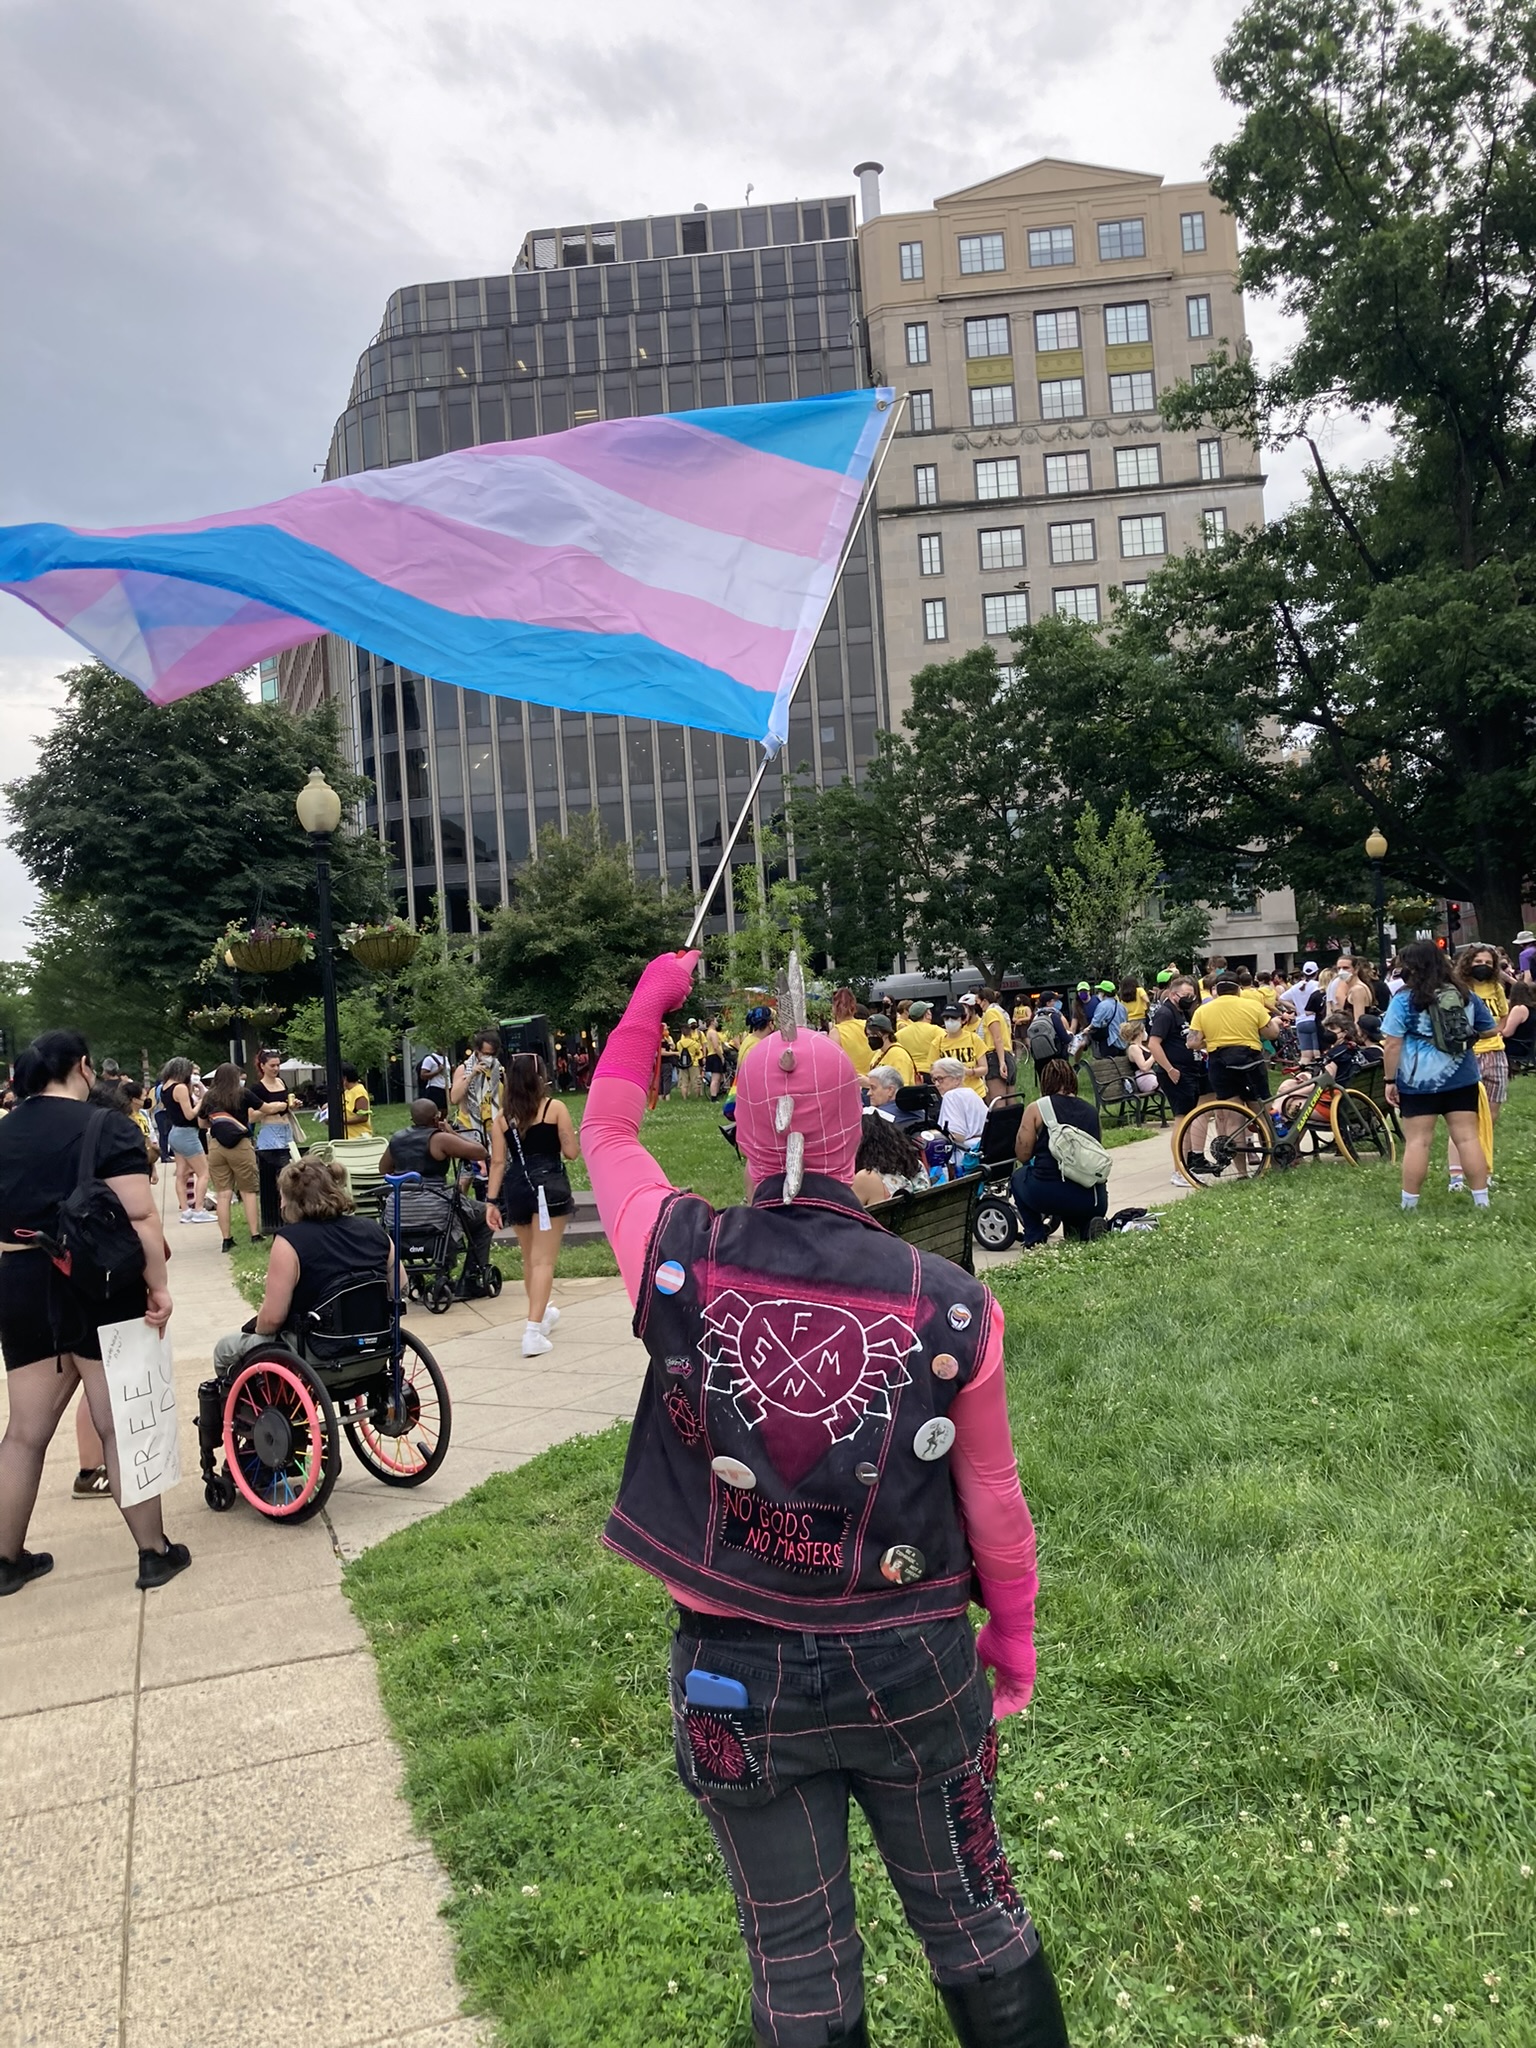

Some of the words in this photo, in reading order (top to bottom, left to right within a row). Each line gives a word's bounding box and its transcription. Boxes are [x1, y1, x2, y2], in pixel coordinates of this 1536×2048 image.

[1297, 1106, 1313, 1132] SANTA
[1310, 1086, 1323, 1107] CRUZ
[791, 1312, 812, 1342] F
[751, 1336, 772, 1369] S
[816, 1350, 840, 1375] M
[783, 1378, 806, 1398] N
[123, 1370, 163, 1491] FREE
[92, 1476, 109, 1490] N
[725, 1490, 752, 1521] NO
[760, 1506, 813, 1540] GODS
[745, 1527, 770, 1552] NO
[773, 1536, 842, 1567] MASTERS
